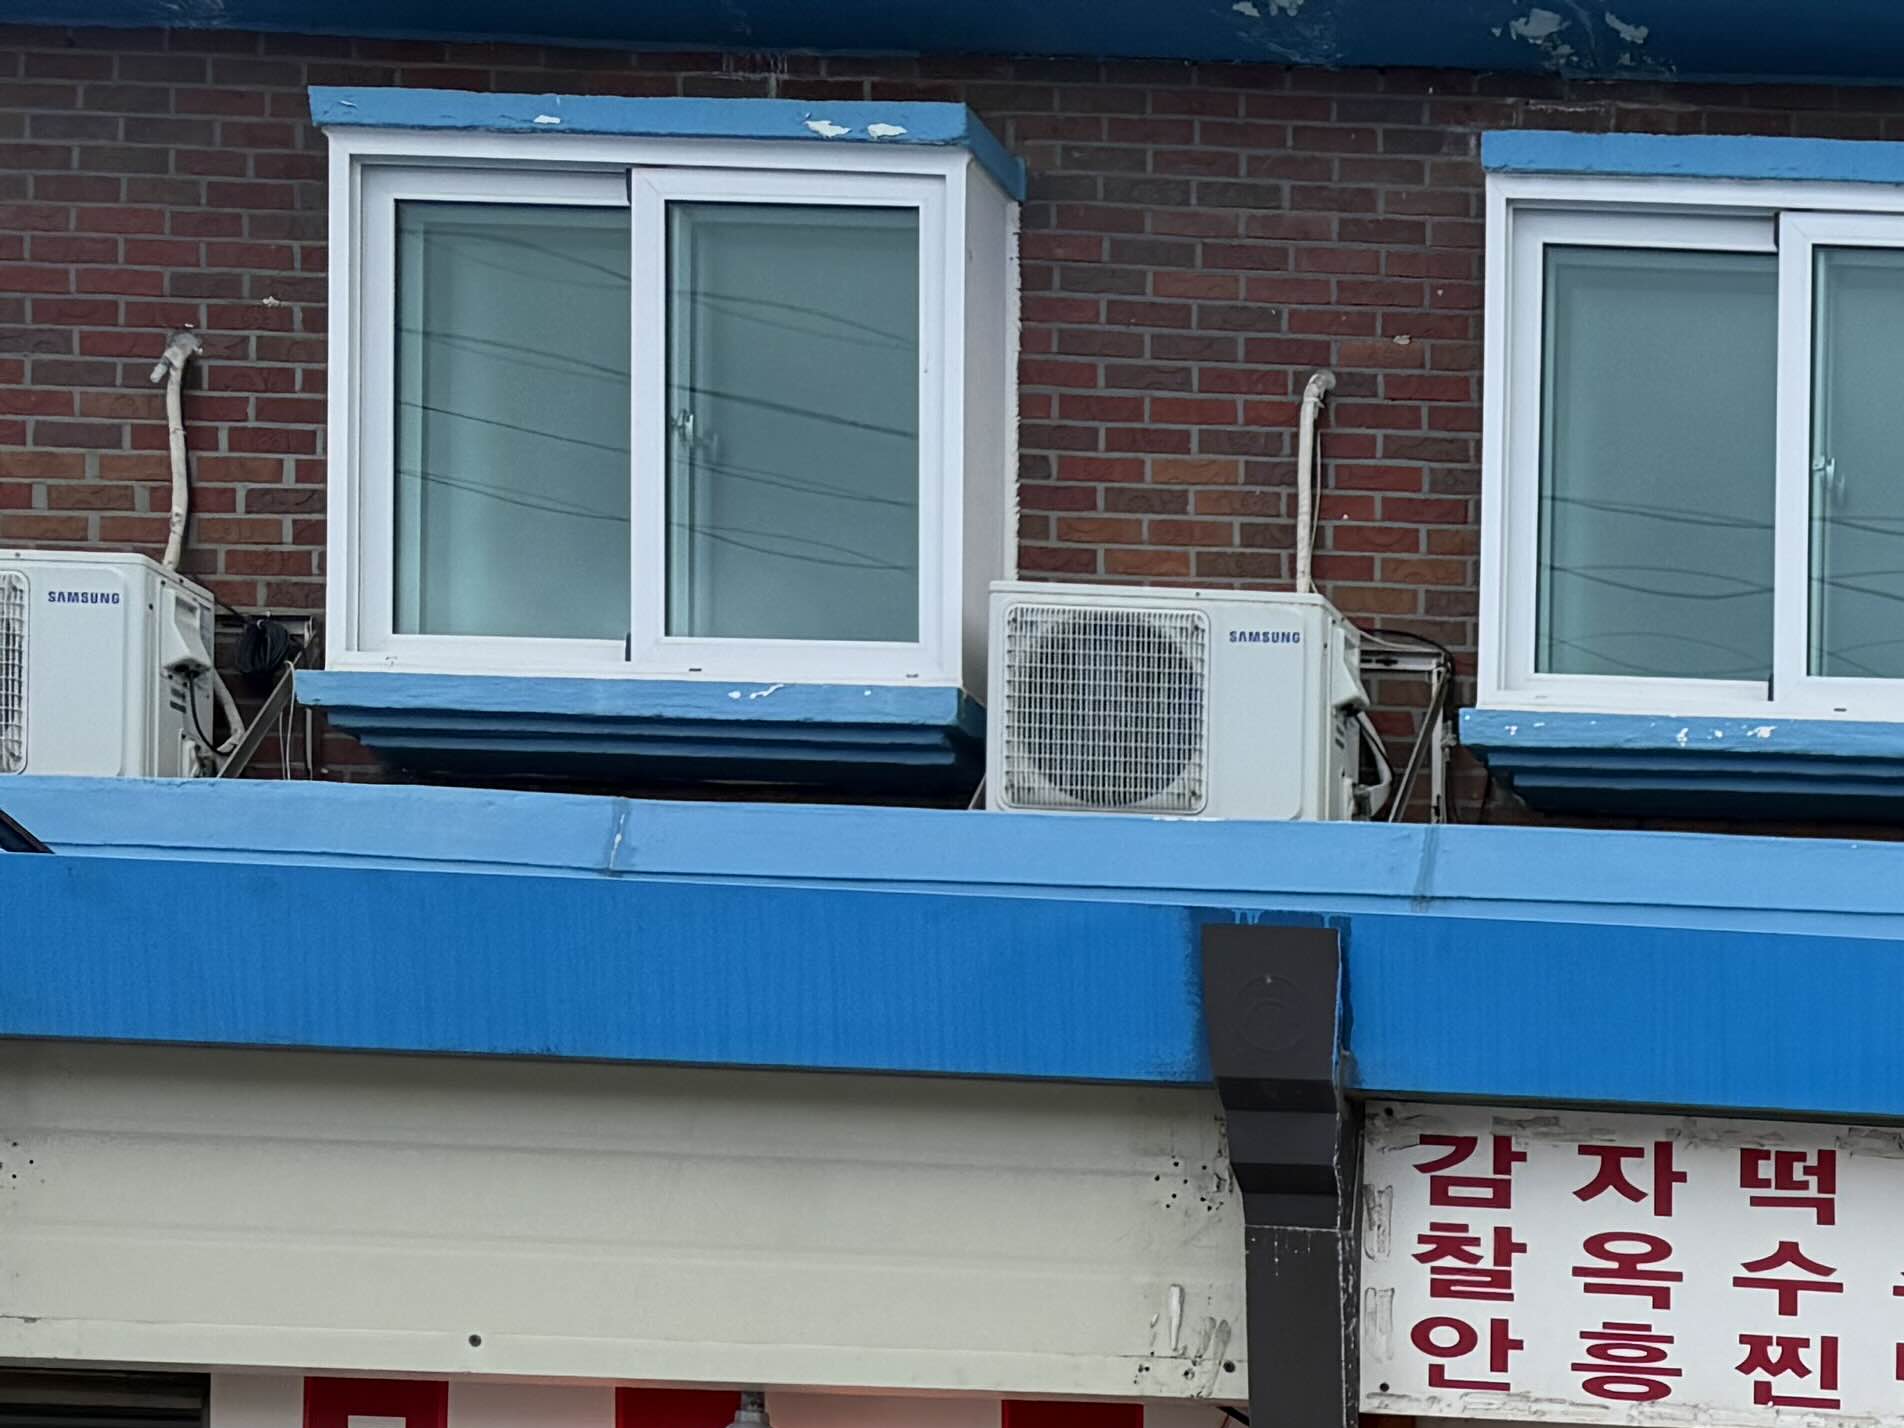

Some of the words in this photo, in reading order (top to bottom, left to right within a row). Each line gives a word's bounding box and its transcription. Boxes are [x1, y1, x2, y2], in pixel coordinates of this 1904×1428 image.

[47, 590, 121, 605] SAMSUNG
[1229, 630, 1301, 644] SAMSUNG
[1416, 1133, 1838, 1226] 감자떡
